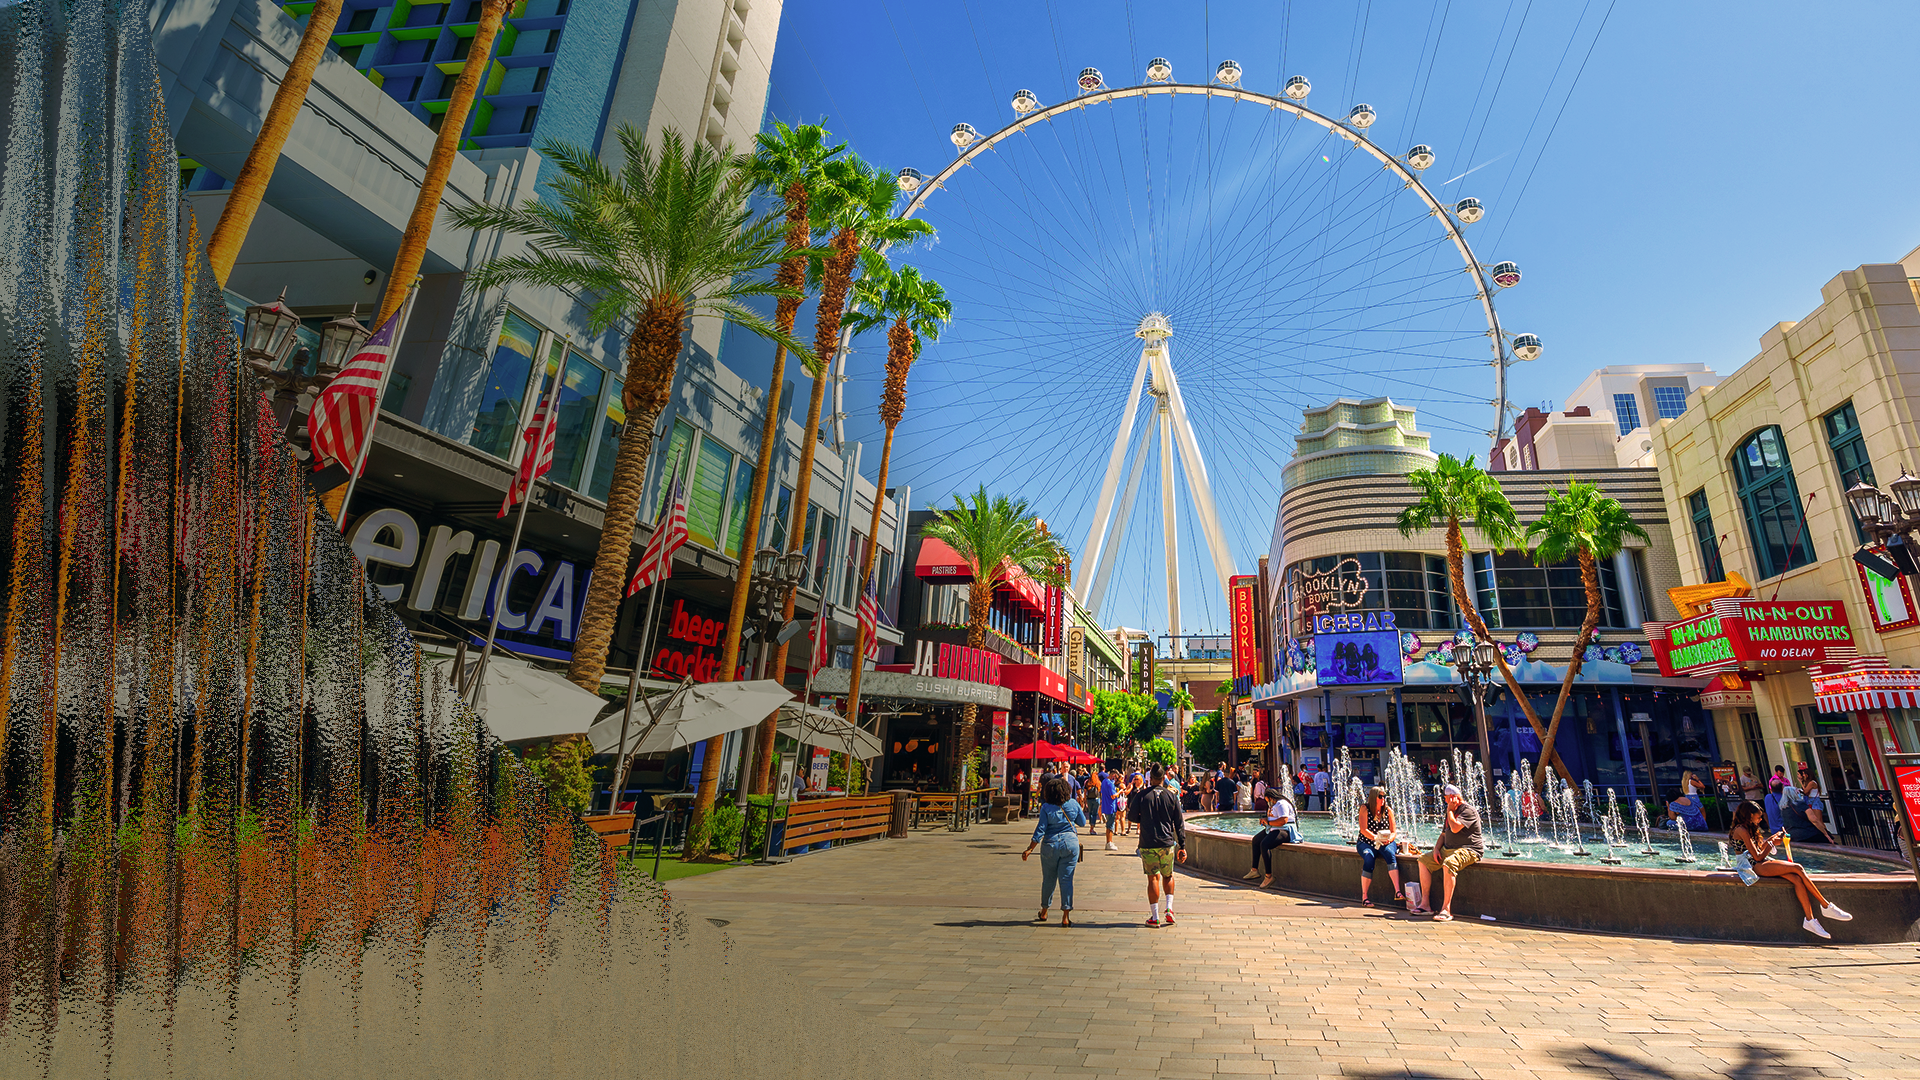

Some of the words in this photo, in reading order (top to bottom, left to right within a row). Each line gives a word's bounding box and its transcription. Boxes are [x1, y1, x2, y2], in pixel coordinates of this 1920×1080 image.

[931, 566, 957, 575] PASTRIES
[1308, 592, 1337, 604] BOWL
[1743, 606, 1833, 621] IN-N-OUT
[668, 599, 724, 647] beer
[1312, 611, 1398, 634] ICEBAR
[1671, 616, 1723, 646] IN-N-OUT
[1748, 625, 1851, 641] HAMBURGERS
[1760, 649, 1777, 658] NO
[1781, 648, 1815, 657] DELAY
[650, 646, 745, 682] cocktas
[911, 640, 934, 677] JA
[937, 642, 1002, 686] BURRITOS
[915, 682, 954, 694] SUSHI
[957, 686, 997, 700] BURRITOS
[812, 762, 828, 770] BEER
